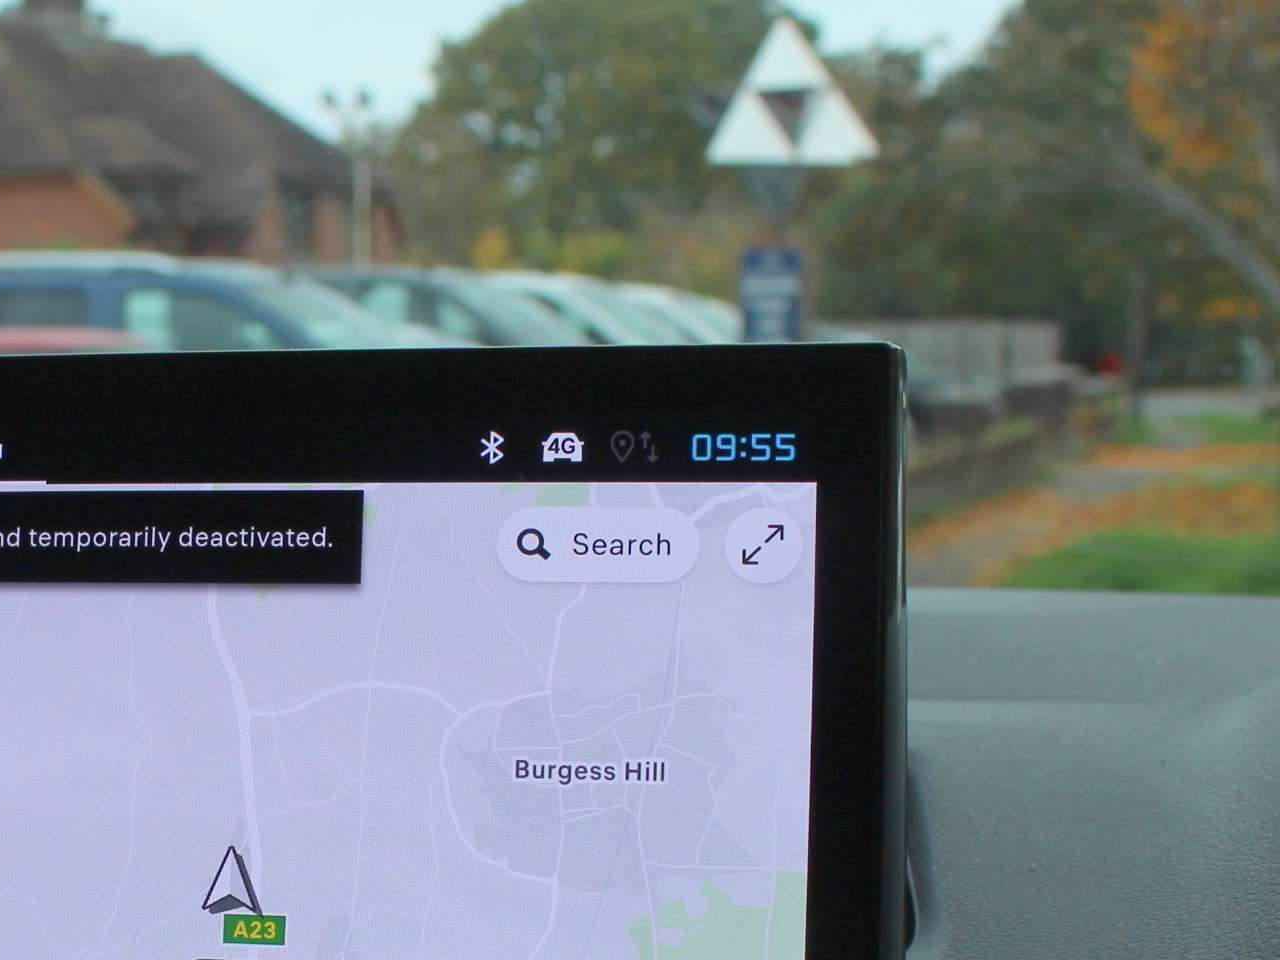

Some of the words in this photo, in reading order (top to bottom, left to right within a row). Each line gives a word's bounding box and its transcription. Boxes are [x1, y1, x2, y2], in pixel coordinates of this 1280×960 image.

[691, 433, 797, 462] 09:55
[29, 526, 171, 552] temporarily
[178, 526, 333, 547] deactivated.
[572, 532, 672, 556] Search
[515, 759, 616, 785] Burgess
[625, 762, 666, 782] Hill
[233, 920, 277, 939] A23
